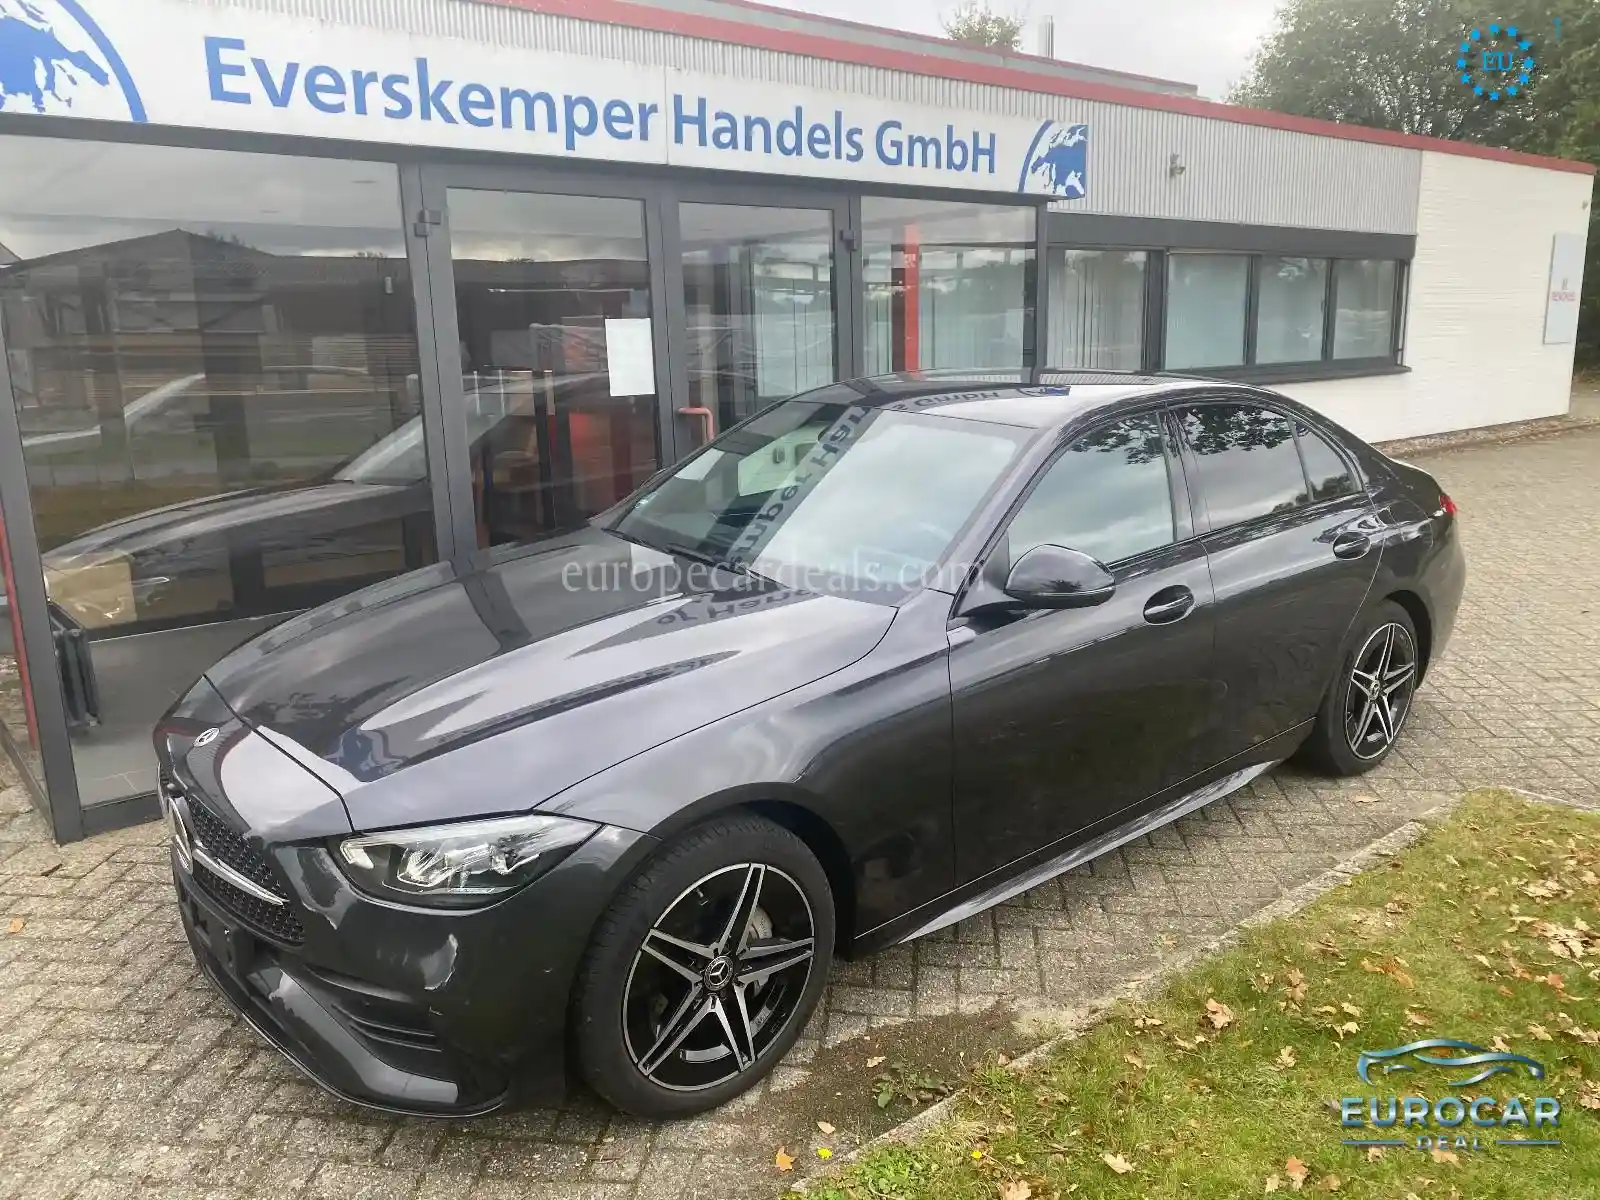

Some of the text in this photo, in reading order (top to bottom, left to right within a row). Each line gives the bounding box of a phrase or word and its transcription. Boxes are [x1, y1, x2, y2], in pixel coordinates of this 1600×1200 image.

[204, 36, 996, 174] Everskemper Handels GmbH
